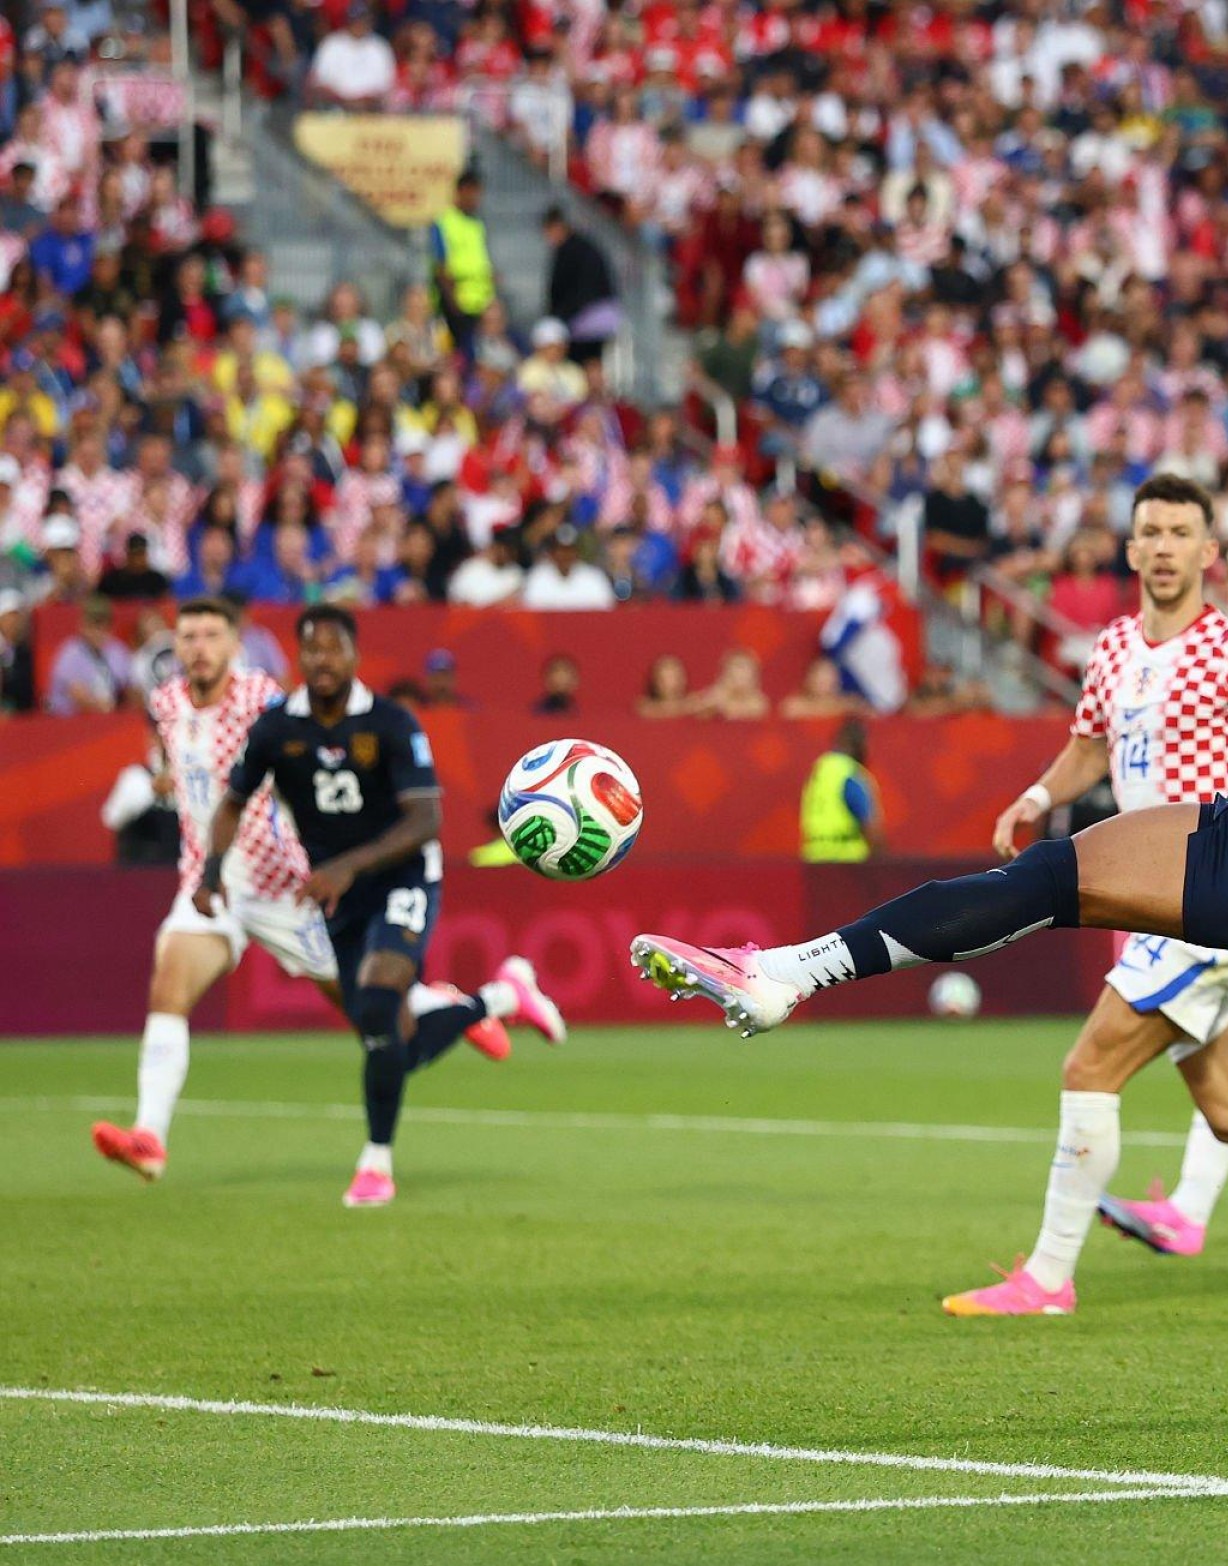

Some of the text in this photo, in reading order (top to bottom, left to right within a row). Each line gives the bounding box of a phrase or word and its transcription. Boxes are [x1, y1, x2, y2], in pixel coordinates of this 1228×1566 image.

[1121, 731, 1149, 780] 14
[312, 768, 364, 814] 23
[385, 886, 428, 934] 23
